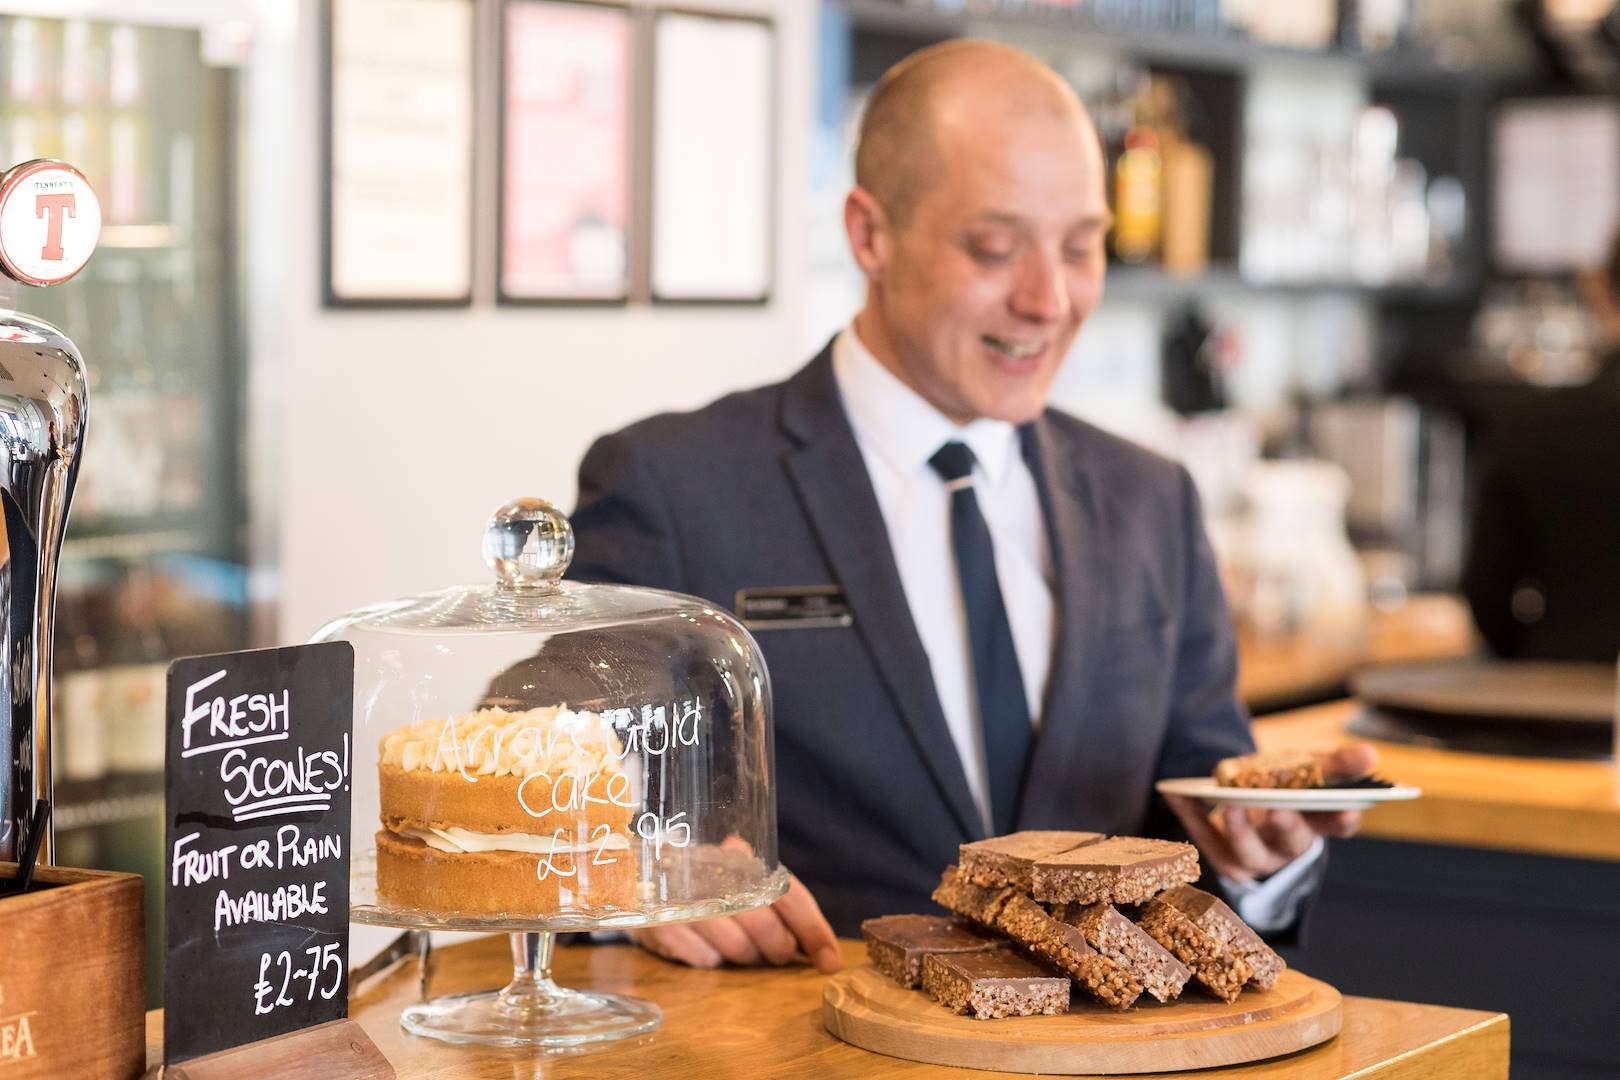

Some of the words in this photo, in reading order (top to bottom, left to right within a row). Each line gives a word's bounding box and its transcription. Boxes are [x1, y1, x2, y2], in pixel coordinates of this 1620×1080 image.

[36, 194, 76, 260] T
[182, 669, 289, 749] FRESH
[220, 732, 349, 805] SCONES!
[172, 832, 238, 887] FRUIT
[240, 840, 274, 869] OR
[276, 824, 342, 870] PLAIN
[214, 881, 328, 931] AVAILABLE
[0, 1016, 37, 1058] EA
